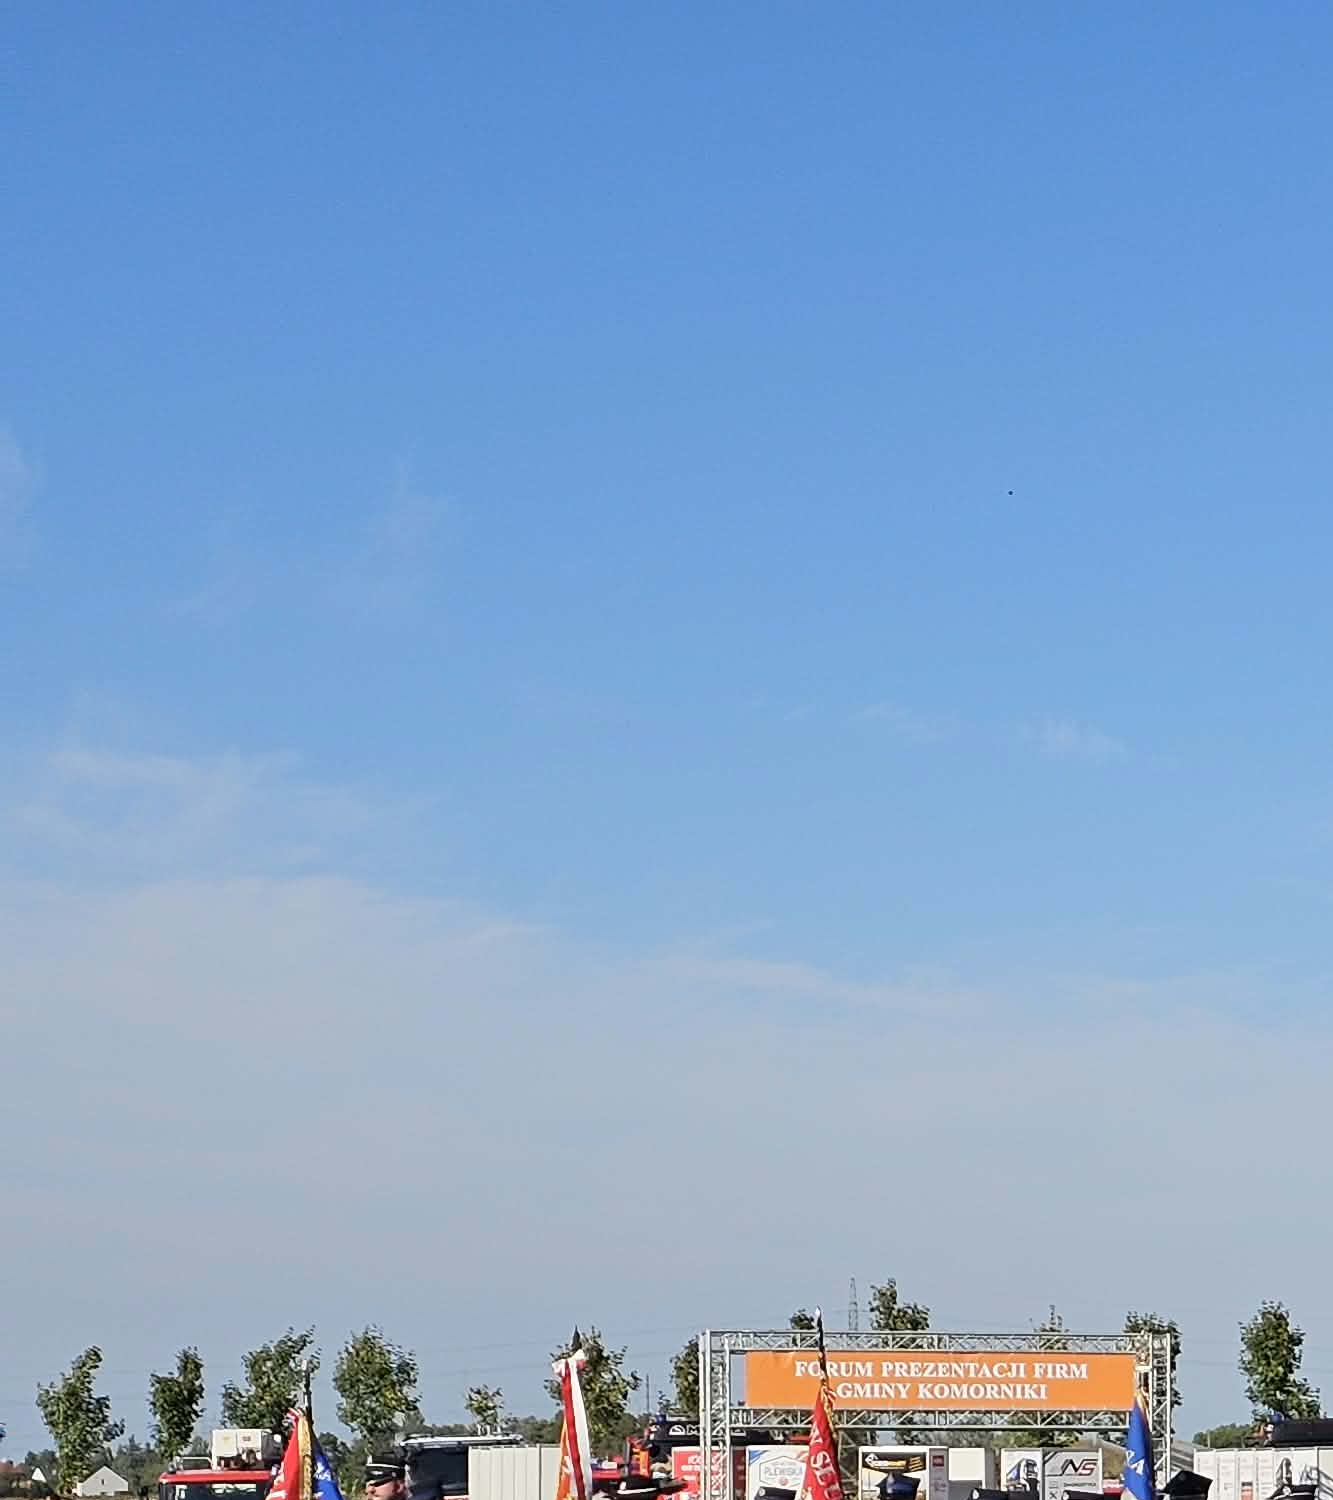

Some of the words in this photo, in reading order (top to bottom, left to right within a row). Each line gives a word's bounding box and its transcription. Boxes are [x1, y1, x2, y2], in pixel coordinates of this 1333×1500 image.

[794, 1360, 874, 1377] FORUM
[881, 1361, 1027, 1379] PREZENTACJI
[1033, 1362, 1088, 1379] FIRM
[836, 1382, 911, 1399] GMINY
[918, 1383, 1048, 1400] KOMORNIKI
